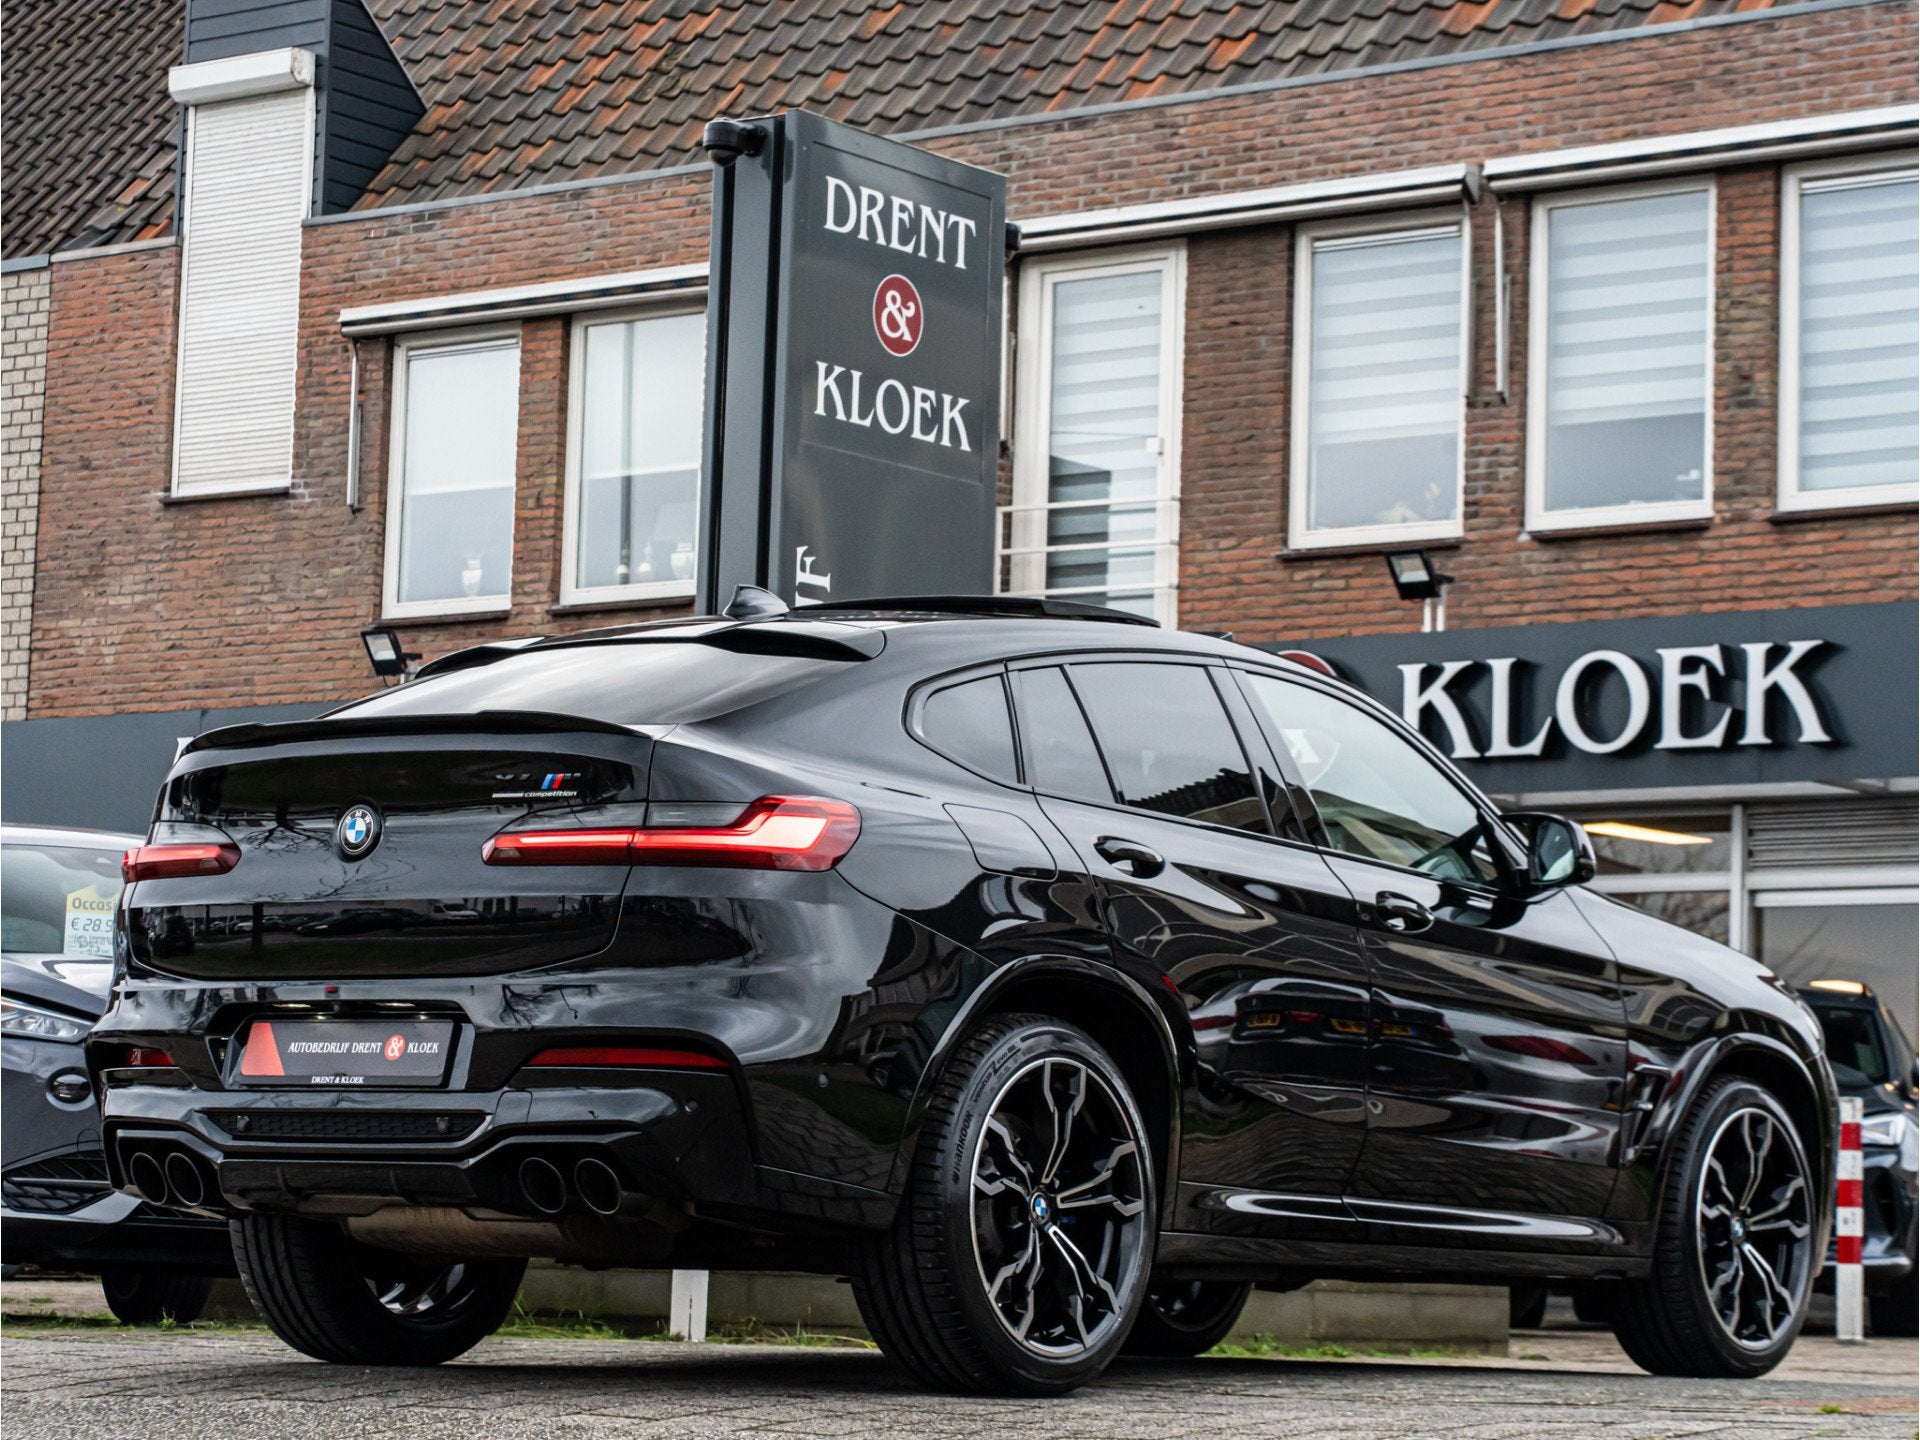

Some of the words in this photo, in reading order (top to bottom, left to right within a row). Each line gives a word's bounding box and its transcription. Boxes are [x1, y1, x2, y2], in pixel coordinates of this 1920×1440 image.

[824, 176, 977, 270] DRENT
[881, 290, 916, 342] &
[814, 361, 971, 452] KLOEK
[1396, 639, 1833, 760] KLOEK
[524, 790, 577, 798] competition
[72, 897, 114, 911] Occas
[288, 1042, 350, 1053] AUTOBEDRIJF
[351, 1042, 382, 1053] DRENT
[387, 1037, 403, 1056] &
[407, 1042, 439, 1053] KLOEK
[341, 1076, 364, 1084] KLOEK
